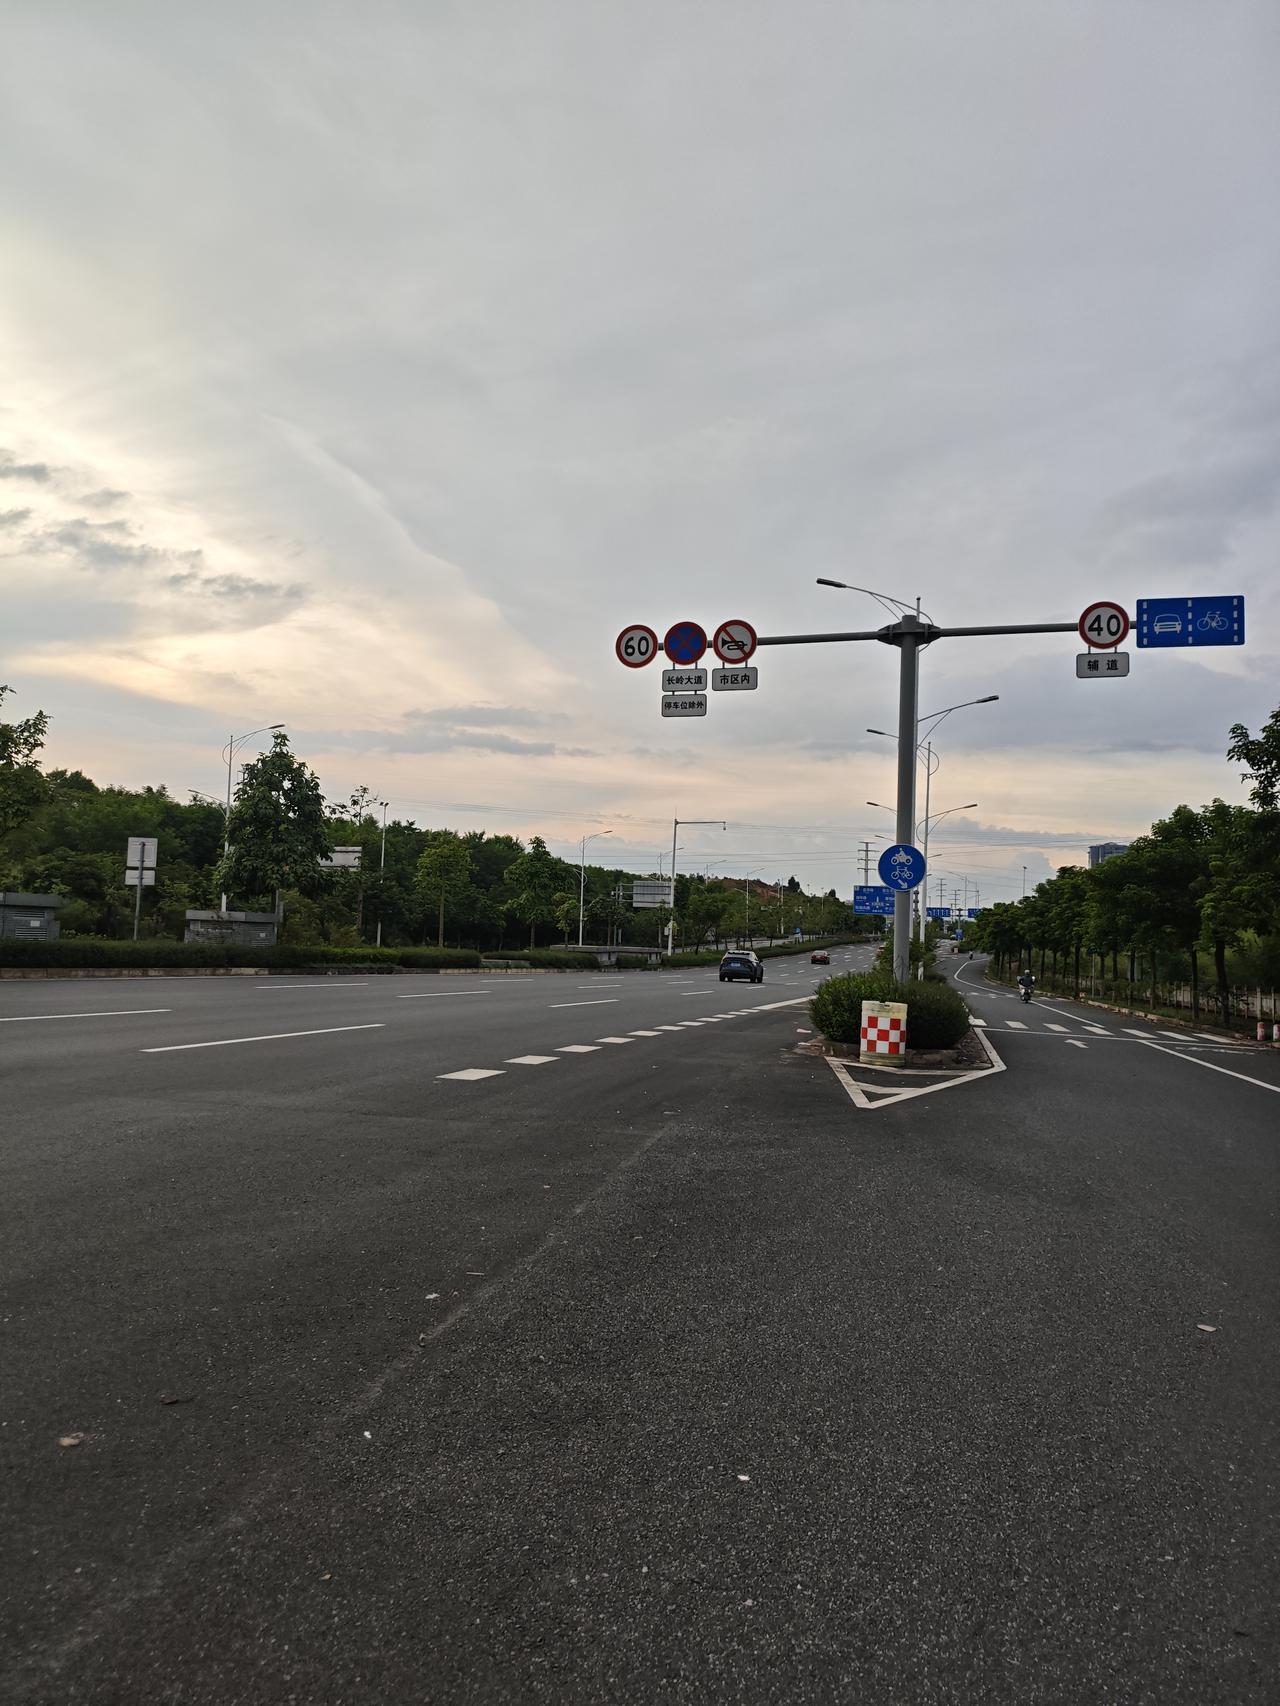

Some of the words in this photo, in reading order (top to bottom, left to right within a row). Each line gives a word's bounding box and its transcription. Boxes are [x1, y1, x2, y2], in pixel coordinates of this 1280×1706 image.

[1088, 614, 1121, 636] 40
[624, 636, 650, 657] 60
[1087, 659, 1119, 672] 辅道
[666, 675, 704, 685] 长岭大道
[719, 673, 750, 685] 市区内
[664, 700, 705, 710] 停车位除外
